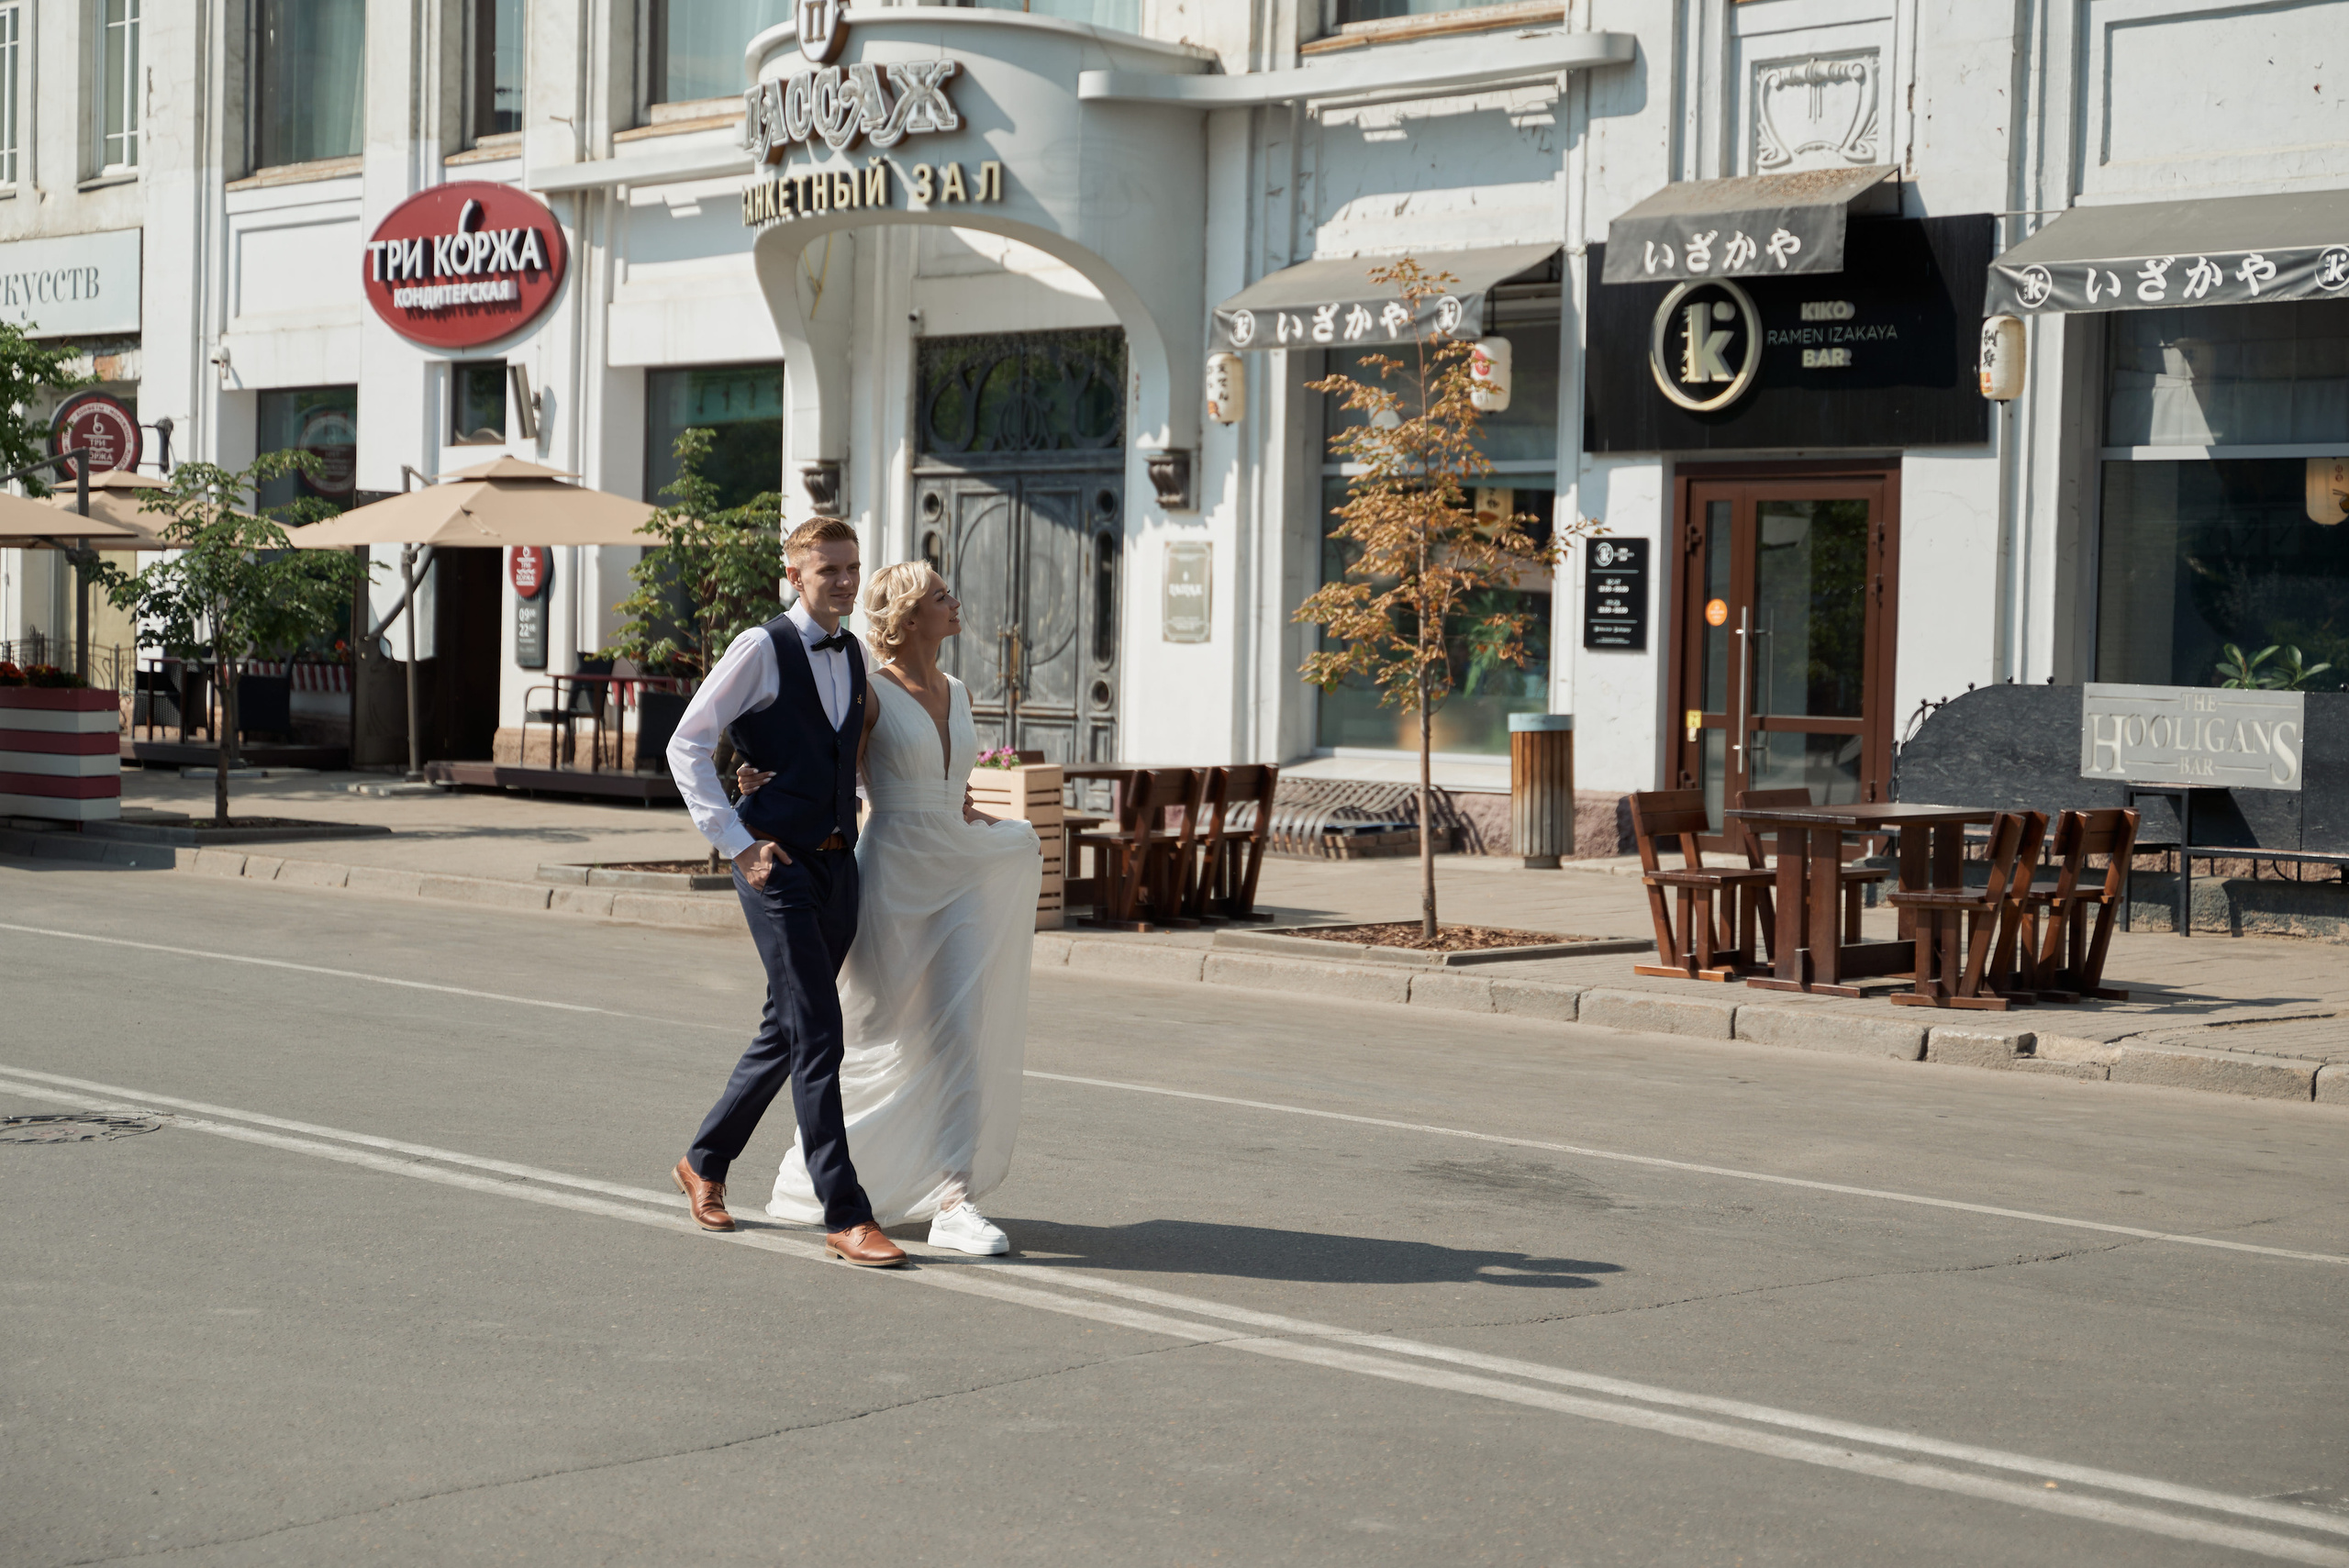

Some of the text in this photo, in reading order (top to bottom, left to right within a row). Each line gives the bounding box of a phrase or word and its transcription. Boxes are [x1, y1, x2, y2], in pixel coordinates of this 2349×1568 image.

[743, 59, 959, 164] ПАССАЖ
[912, 161, 1001, 205] ЗАЛ
[367, 198, 542, 282] ТРИ КОРЖА
[1643, 227, 1801, 274] いざかや
[2086, 252, 2277, 304] いざかや
[394, 280, 510, 310] КОНДИТЕРСКАЯ
[1800, 300, 1849, 320] KIKO
[1276, 301, 1409, 344] いざかや
[1767, 324, 1898, 345] RAMEN IZAKAYA
[1801, 347, 1846, 368] BAR
[89, 439, 106, 447] ТРИ
[89, 450, 114, 462] ОРЖА
[2180, 692, 2218, 713] THE
[2087, 712, 2299, 785] HOOLIGANS
[2178, 754, 2214, 776] BAR
